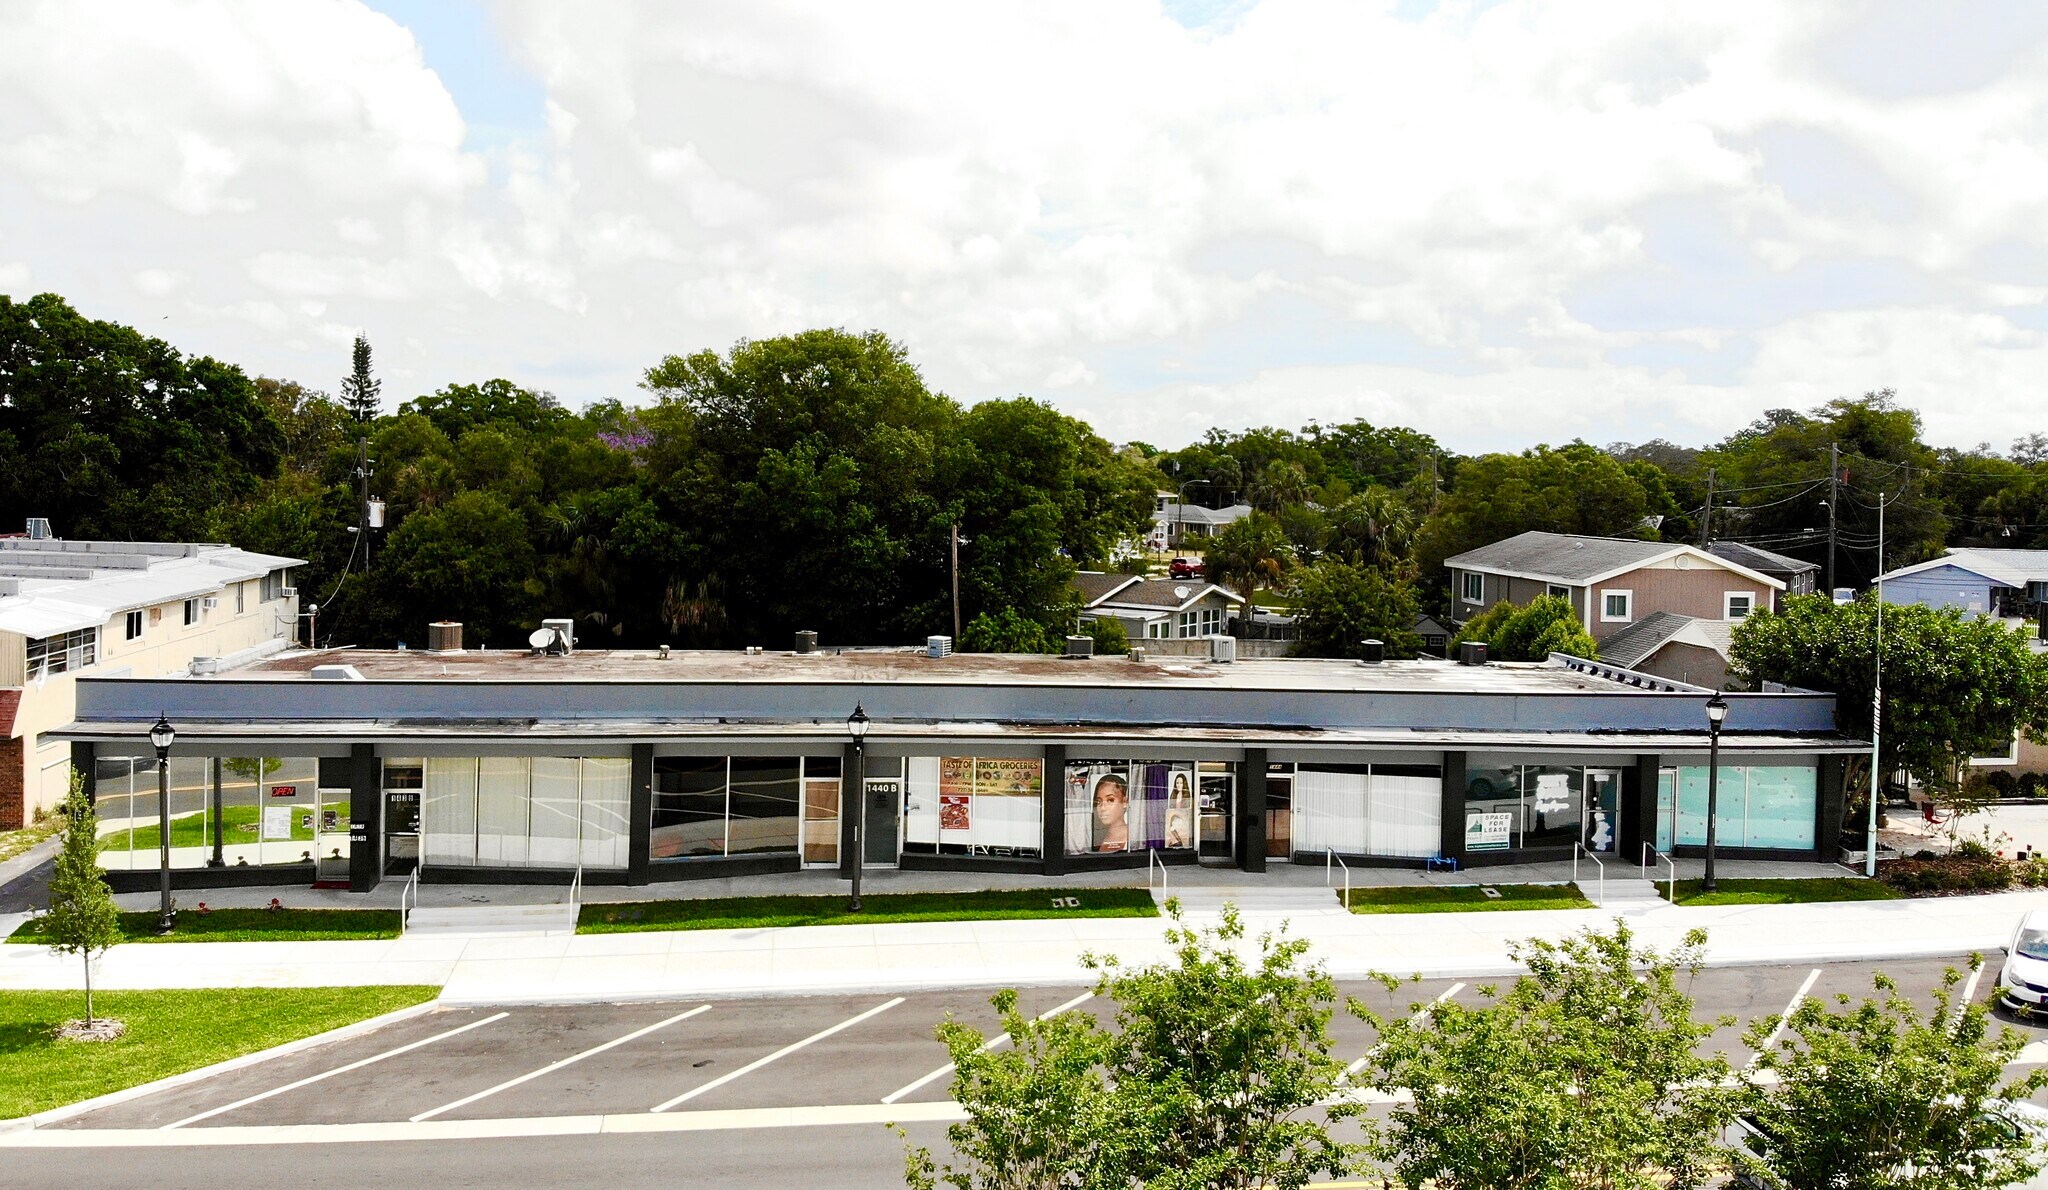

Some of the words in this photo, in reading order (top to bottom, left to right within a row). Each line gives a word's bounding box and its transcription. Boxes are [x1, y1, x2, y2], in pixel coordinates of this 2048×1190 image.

[943, 761, 962, 769] TASTE
[963, 761, 972, 769] OF
[1000, 761, 1038, 770] GROCERIES
[272, 787, 295, 796] OPEN
[867, 784, 889, 792] 1440
[890, 784, 897, 792] B
